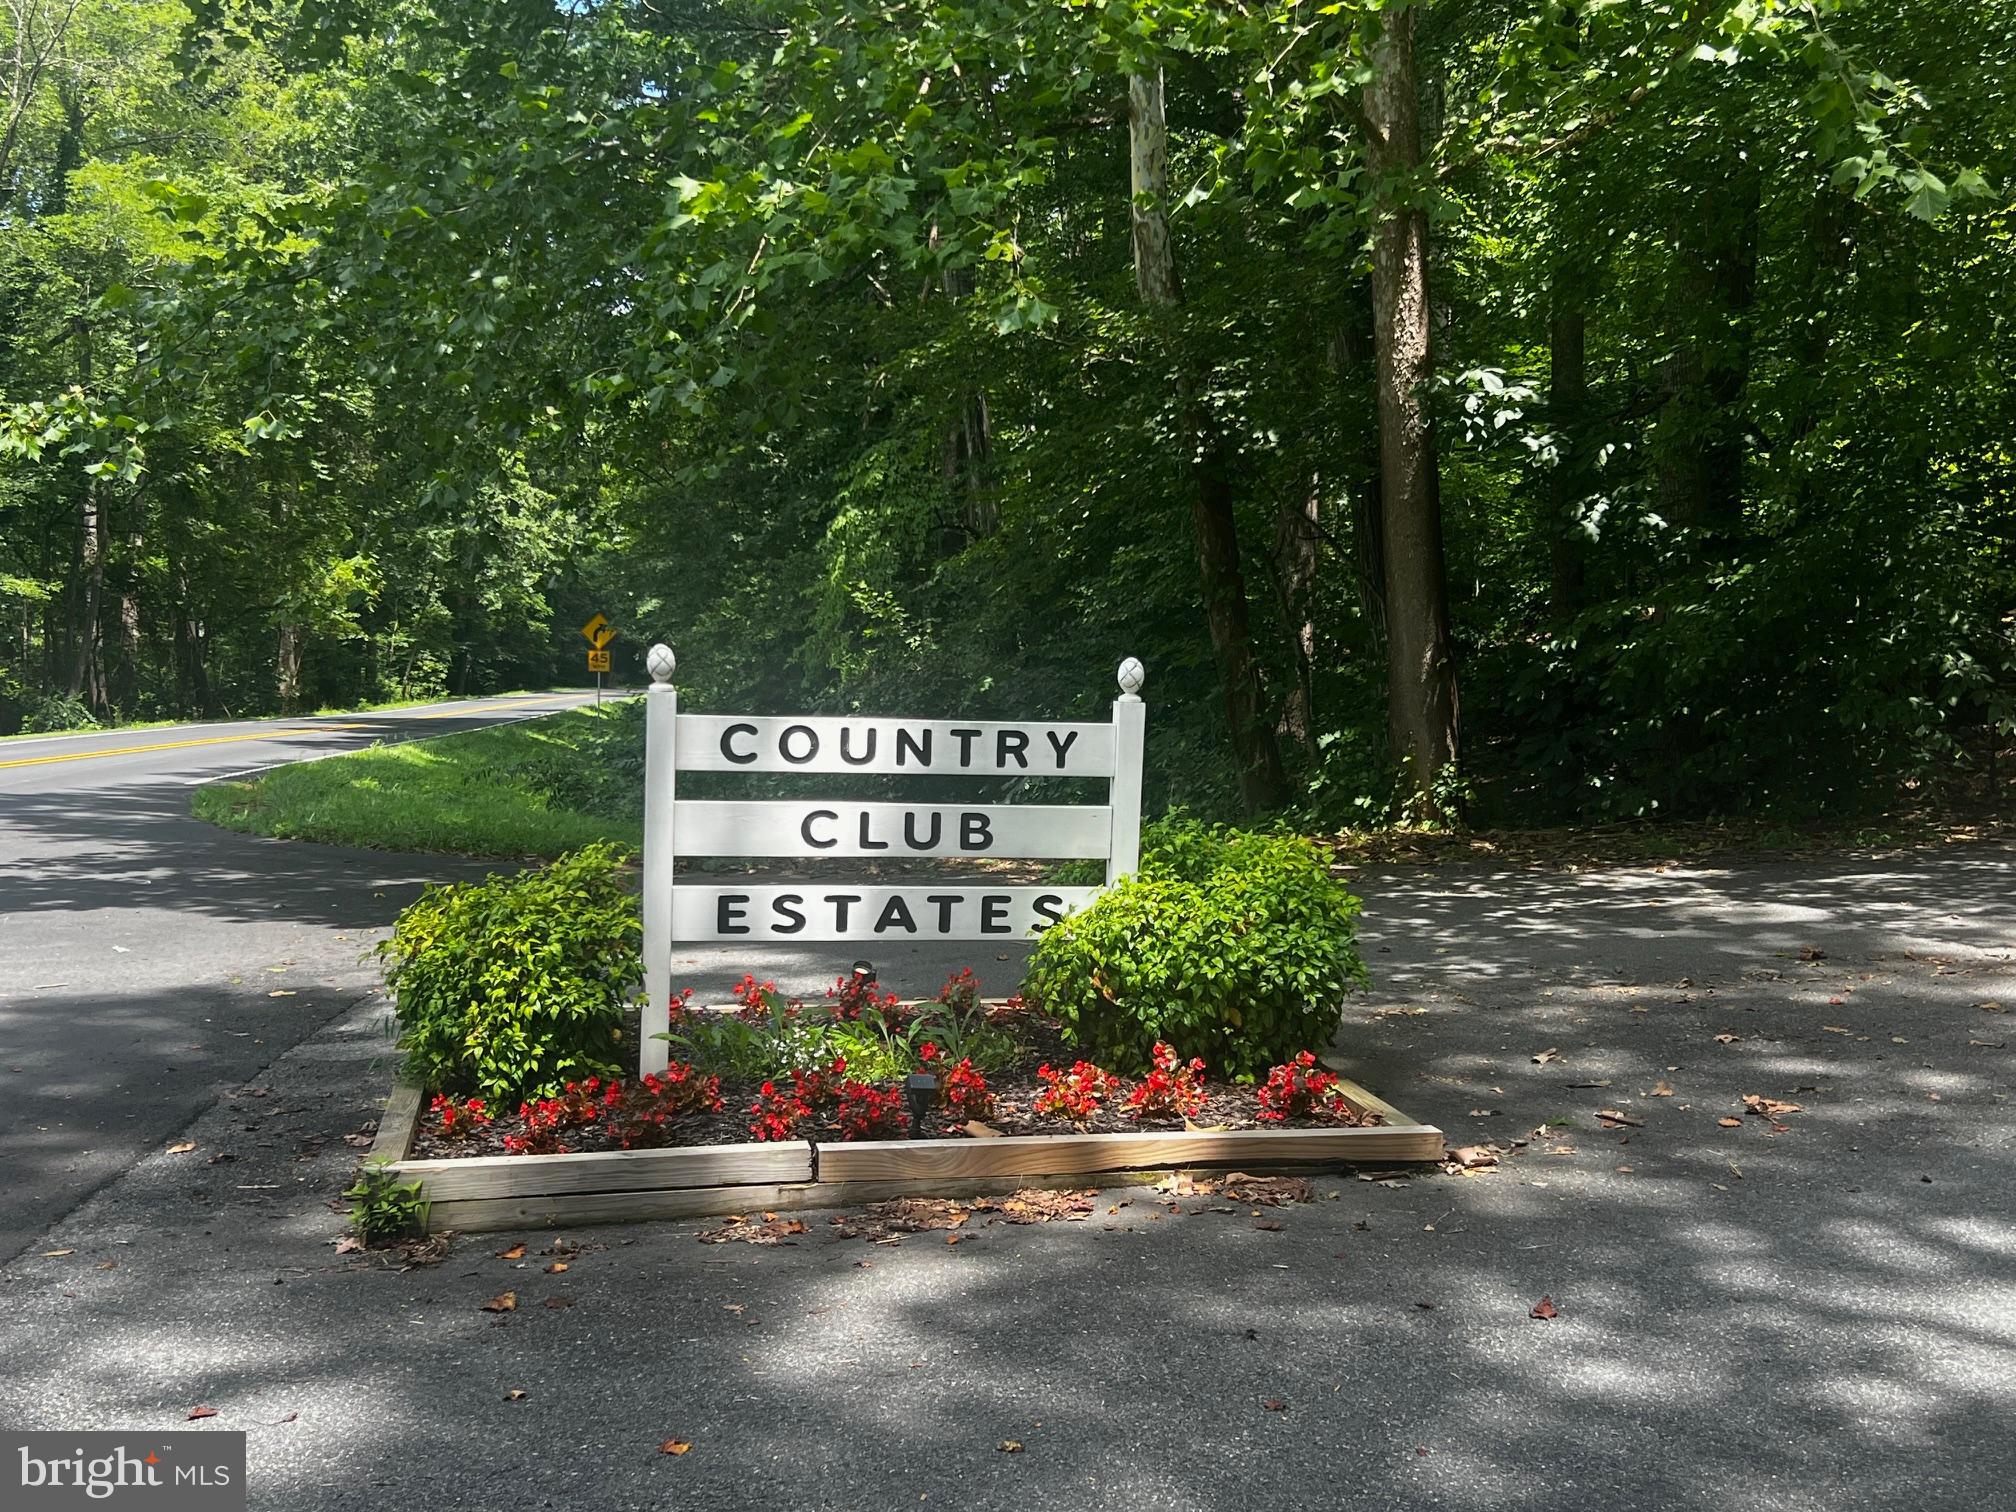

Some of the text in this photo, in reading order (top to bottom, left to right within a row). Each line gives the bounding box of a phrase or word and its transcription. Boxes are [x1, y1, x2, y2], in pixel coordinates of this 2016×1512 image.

[590, 653, 608, 664] 45
[720, 723, 1078, 769] COUNTRY
[801, 810, 993, 850] CLUB
[717, 894, 1063, 934] ESTATES
